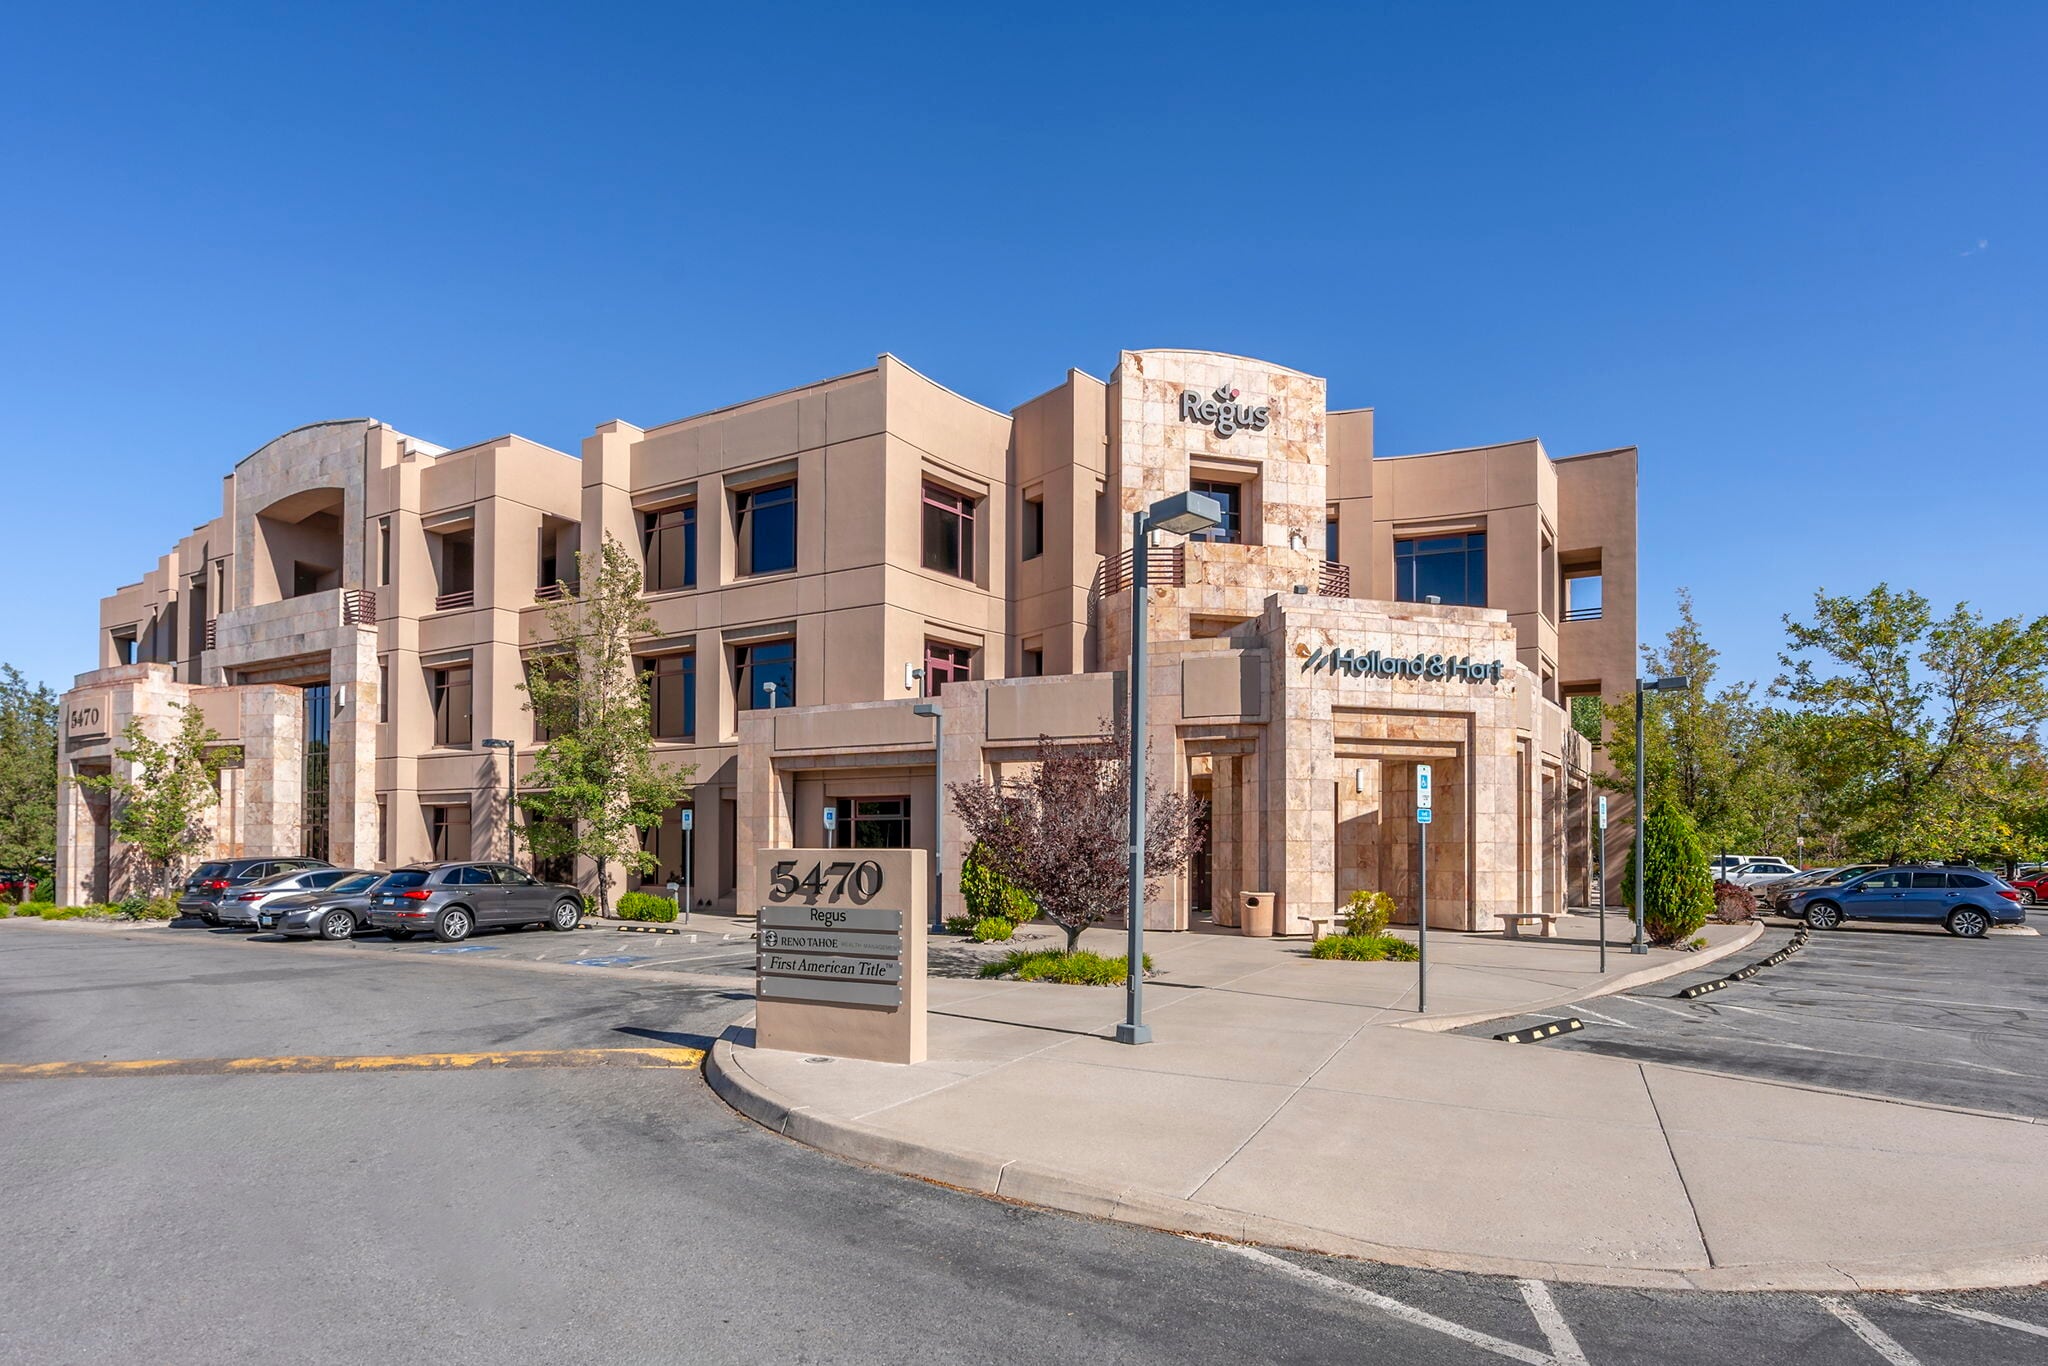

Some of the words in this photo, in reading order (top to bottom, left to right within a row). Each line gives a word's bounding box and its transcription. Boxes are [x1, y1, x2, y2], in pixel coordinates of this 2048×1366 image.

[1182, 389, 1270, 436] Regus
[1336, 649, 1425, 676] Holland
[1428, 654, 1445, 677] &
[1453, 656, 1504, 680] Hart
[71, 708, 99, 728] 5470
[775, 860, 883, 896] 5470
[810, 908, 847, 927] Regus
[781, 936, 806, 948] RENO
[807, 937, 838, 949] TAHOE
[770, 956, 796, 970] First
[798, 958, 855, 975] American
